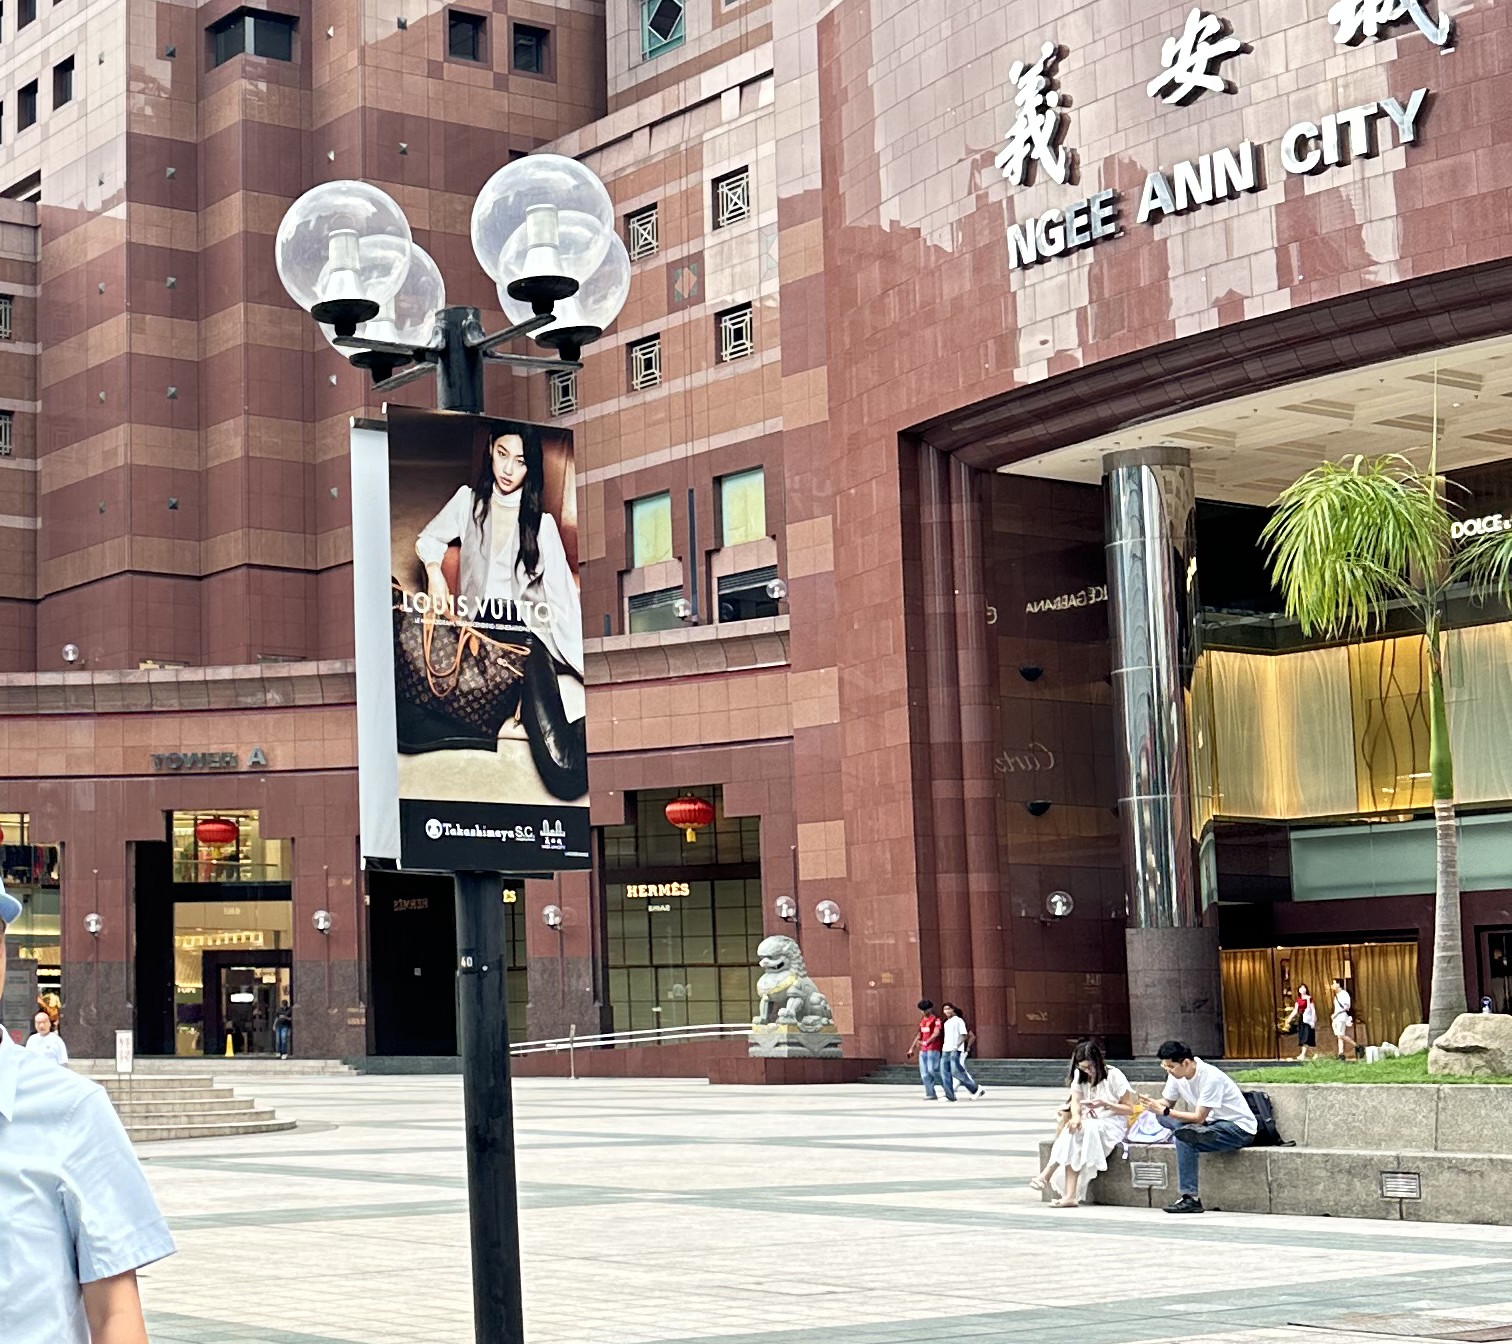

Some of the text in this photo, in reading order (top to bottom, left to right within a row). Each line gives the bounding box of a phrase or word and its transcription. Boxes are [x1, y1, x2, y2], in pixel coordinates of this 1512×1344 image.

[1006, 88, 1429, 270] NGEE ANN CITY
[1451, 514, 1503, 539] DOLCE
[402, 591, 469, 617] LOUIS
[150, 746, 266, 770] TOWER A
[442, 823, 515, 842] Takashimaya
[461, 956, 473, 967] 40
